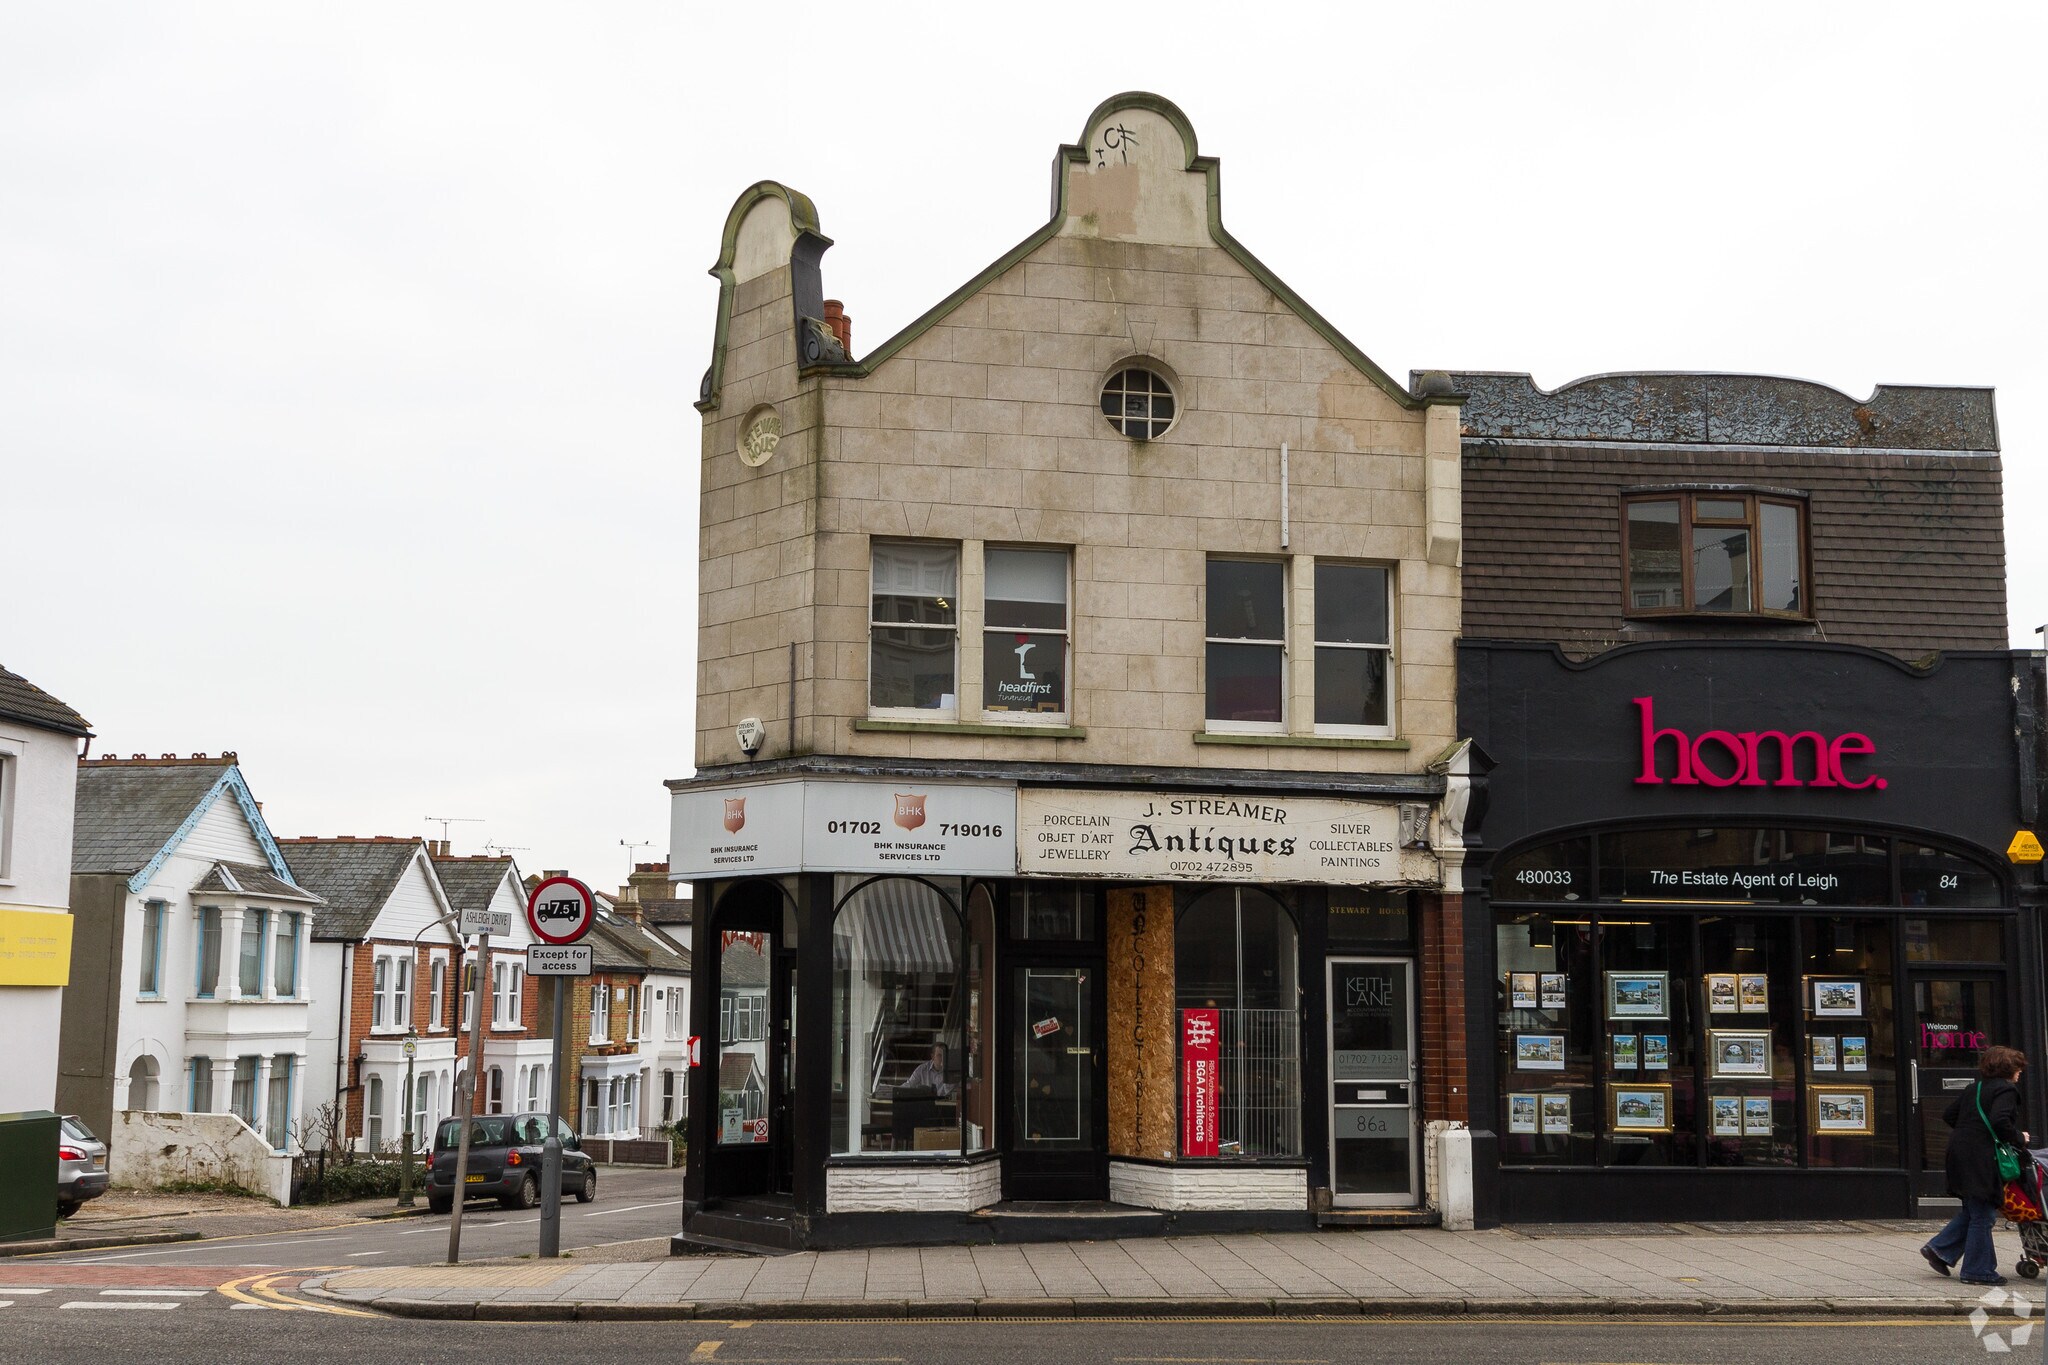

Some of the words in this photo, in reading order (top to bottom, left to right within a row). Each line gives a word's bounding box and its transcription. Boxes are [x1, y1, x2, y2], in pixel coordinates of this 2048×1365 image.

[998, 681, 1051, 694] headfirst
[727, 809, 743, 820] BHK
[899, 806, 922, 816] BHK
[1142, 802, 1162, 818] J.
[1170, 800, 1287, 824] STREAMER
[827, 820, 881, 834] 01702
[1043, 814, 1110, 827] PORCELAIN
[939, 823, 1003, 838] 719016
[1330, 823, 1371, 835] SILVER
[1038, 832, 1077, 845] OBJET
[1081, 831, 1114, 844] D'ART
[710, 845, 724, 854] BHK
[725, 844, 758, 853] INSURANCE
[873, 841, 893, 850] BHK
[895, 842, 946, 851] INSURANCE
[1309, 840, 1393, 852] COLLECTABLES
[713, 855, 742, 864] SERVICES
[743, 854, 755, 863] LTD
[878, 852, 922, 861] SERVICES
[924, 853, 941, 861] LTD
[1038, 848, 1111, 861] JEWELLERY
[1169, 861, 1203, 872] 01702
[1206, 862, 1253, 873] 472895
[1320, 856, 1381, 868] PAINTINGS
[1515, 871, 1572, 886] 480033
[1649, 871, 1678, 886] The
[1682, 871, 1729, 887] Estate
[1731, 872, 1776, 891] Agent
[1779, 872, 1794, 887] of
[1798, 873, 1838, 892] Leigh
[1940, 875, 1958, 889] 84
[464, 911, 490, 924] ASHLEIGH
[491, 913, 508, 926] DRIVE
[532, 950, 569, 960] Except
[572, 950, 587, 959] for
[541, 962, 577, 970] access
[1346, 977, 1392, 992] KEITH
[1339, 1054, 1367, 1064] 01702
[1196, 1060, 1205, 1084] BGA
[1196, 1086, 1205, 1142] Architects
[1207, 1112, 1215, 1142] Surveyors
[1357, 1115, 1387, 1132] 86a
